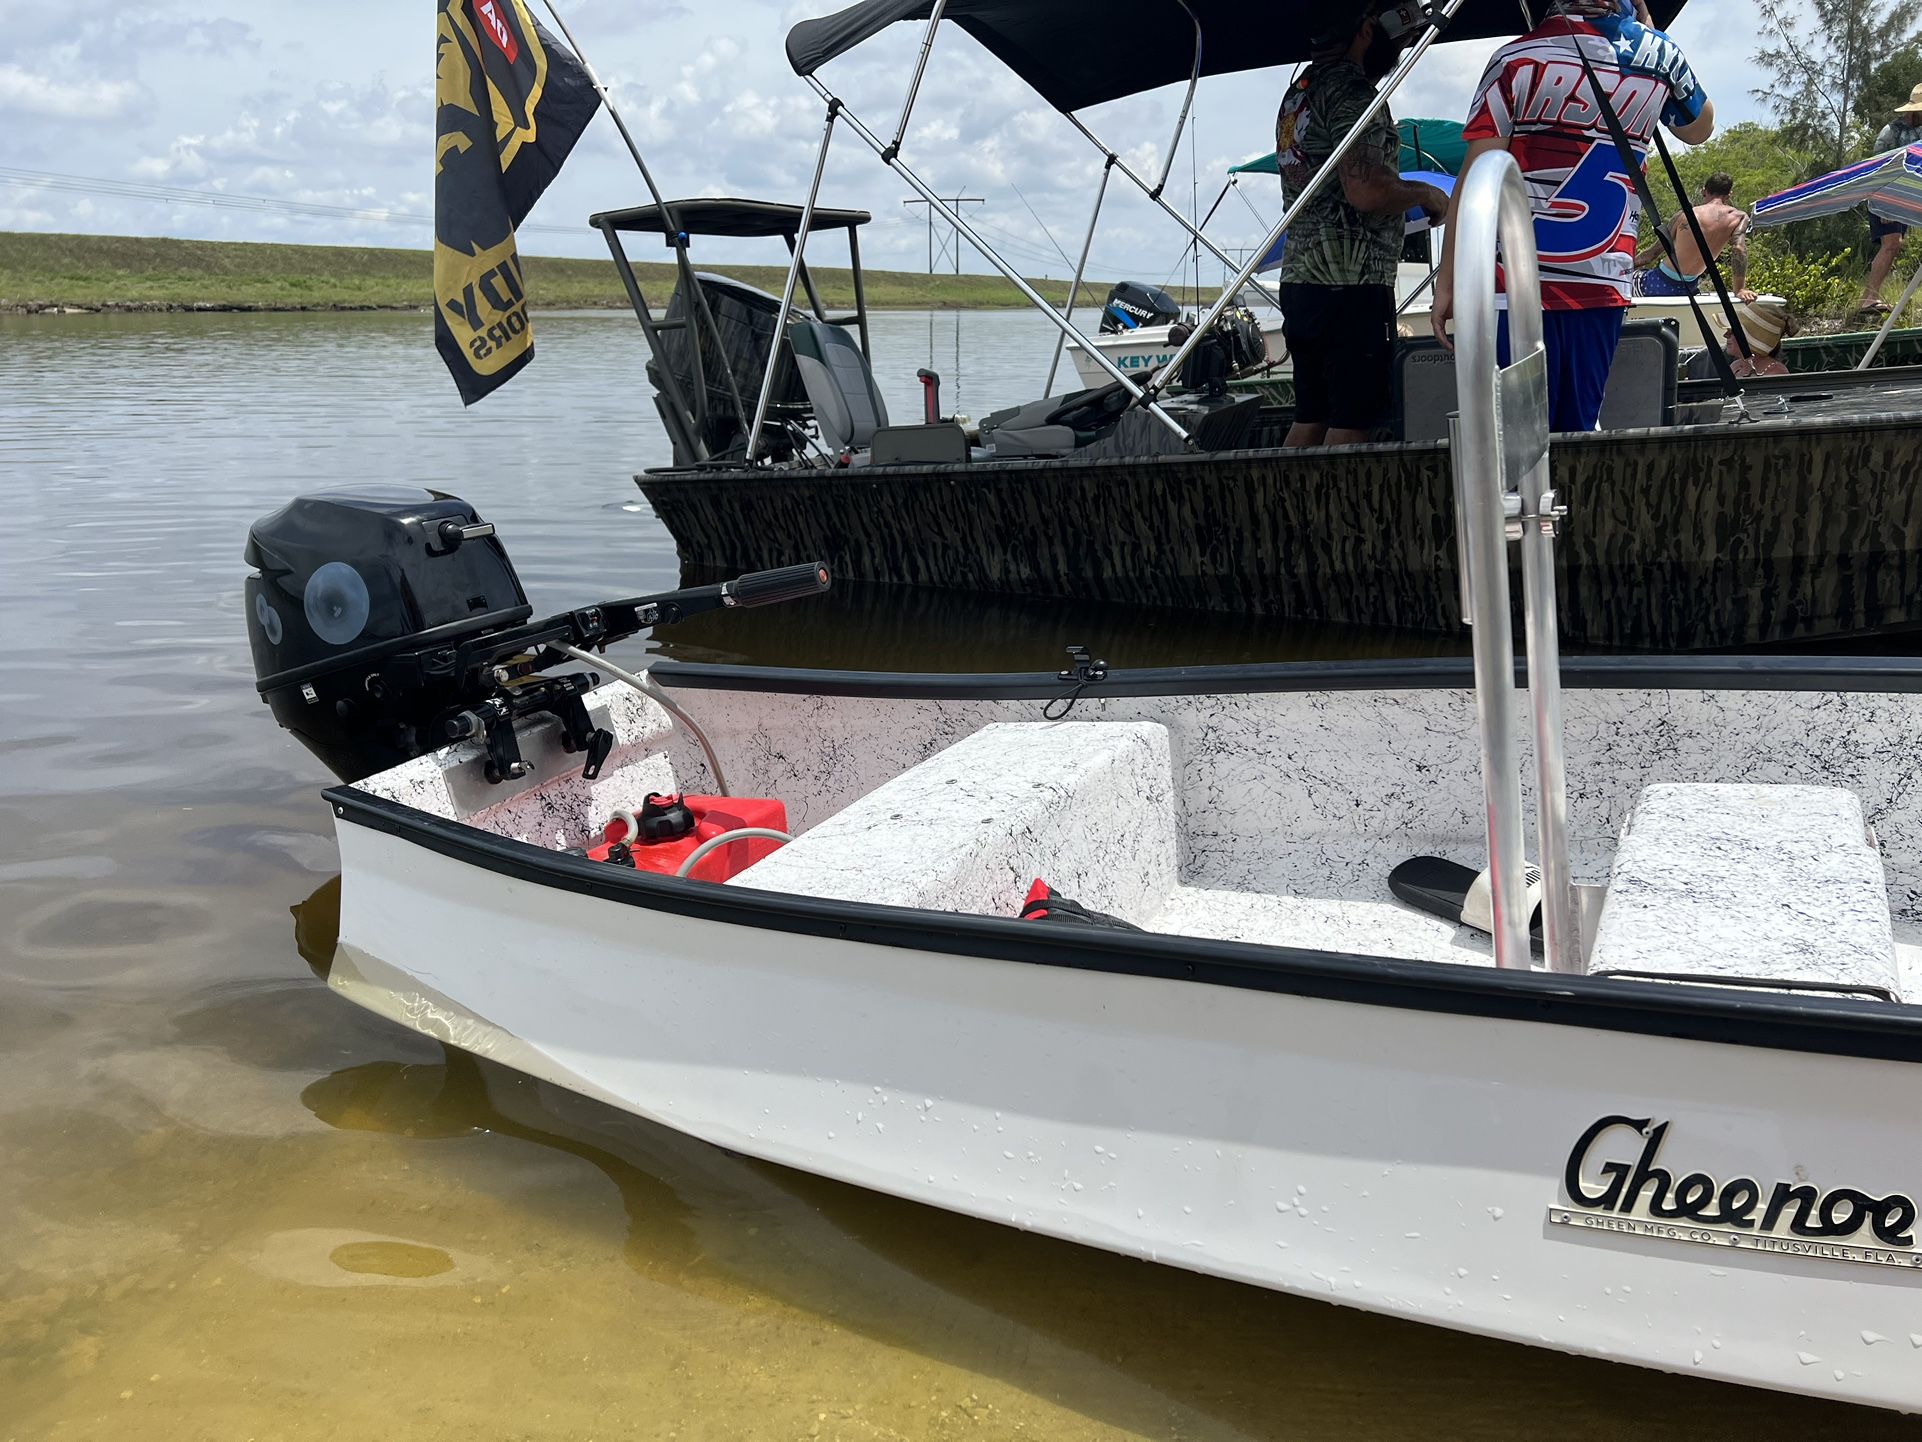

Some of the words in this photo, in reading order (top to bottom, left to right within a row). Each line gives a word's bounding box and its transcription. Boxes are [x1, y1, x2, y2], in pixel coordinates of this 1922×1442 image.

[1532, 139, 1649, 257] 5
[1112, 298, 1154, 319] MERCURY
[1117, 355, 1153, 368] KEY
[1564, 1114, 1917, 1247] Gheenoe
[1585, 1216, 1636, 1232] GHEEN
